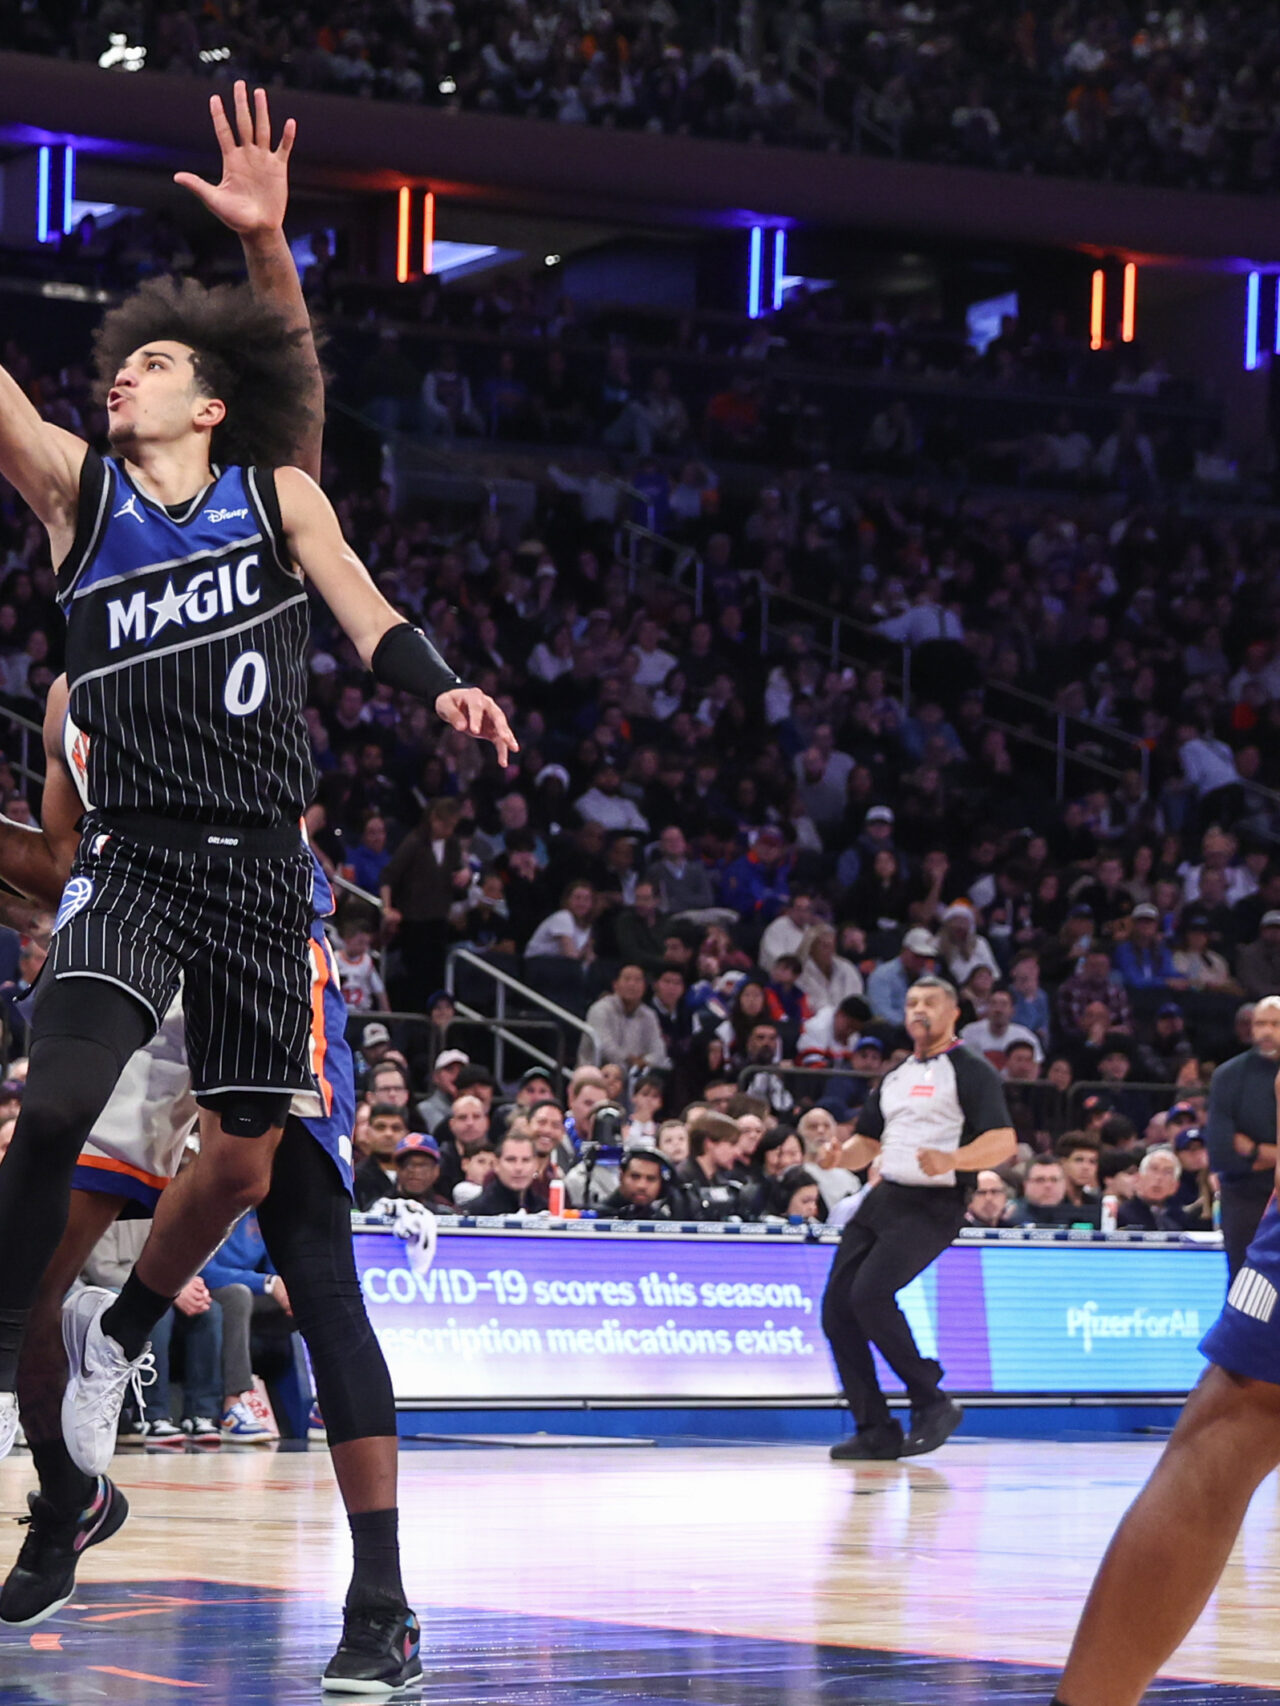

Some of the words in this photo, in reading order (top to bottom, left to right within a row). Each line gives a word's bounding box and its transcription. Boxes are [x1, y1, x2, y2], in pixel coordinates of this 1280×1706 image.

[203, 508, 248, 523] Disney
[224, 651, 267, 716] 0
[208, 836, 239, 846] ORLANDO
[363, 1268, 528, 1304] COVID-19
[533, 1280, 635, 1306] scores
[639, 1273, 698, 1307] this
[701, 1281, 813, 1314] season,
[546, 1319, 732, 1355] medications
[735, 1320, 814, 1355] exist.
[1067, 1301, 1200, 1352] PfizerForAll
